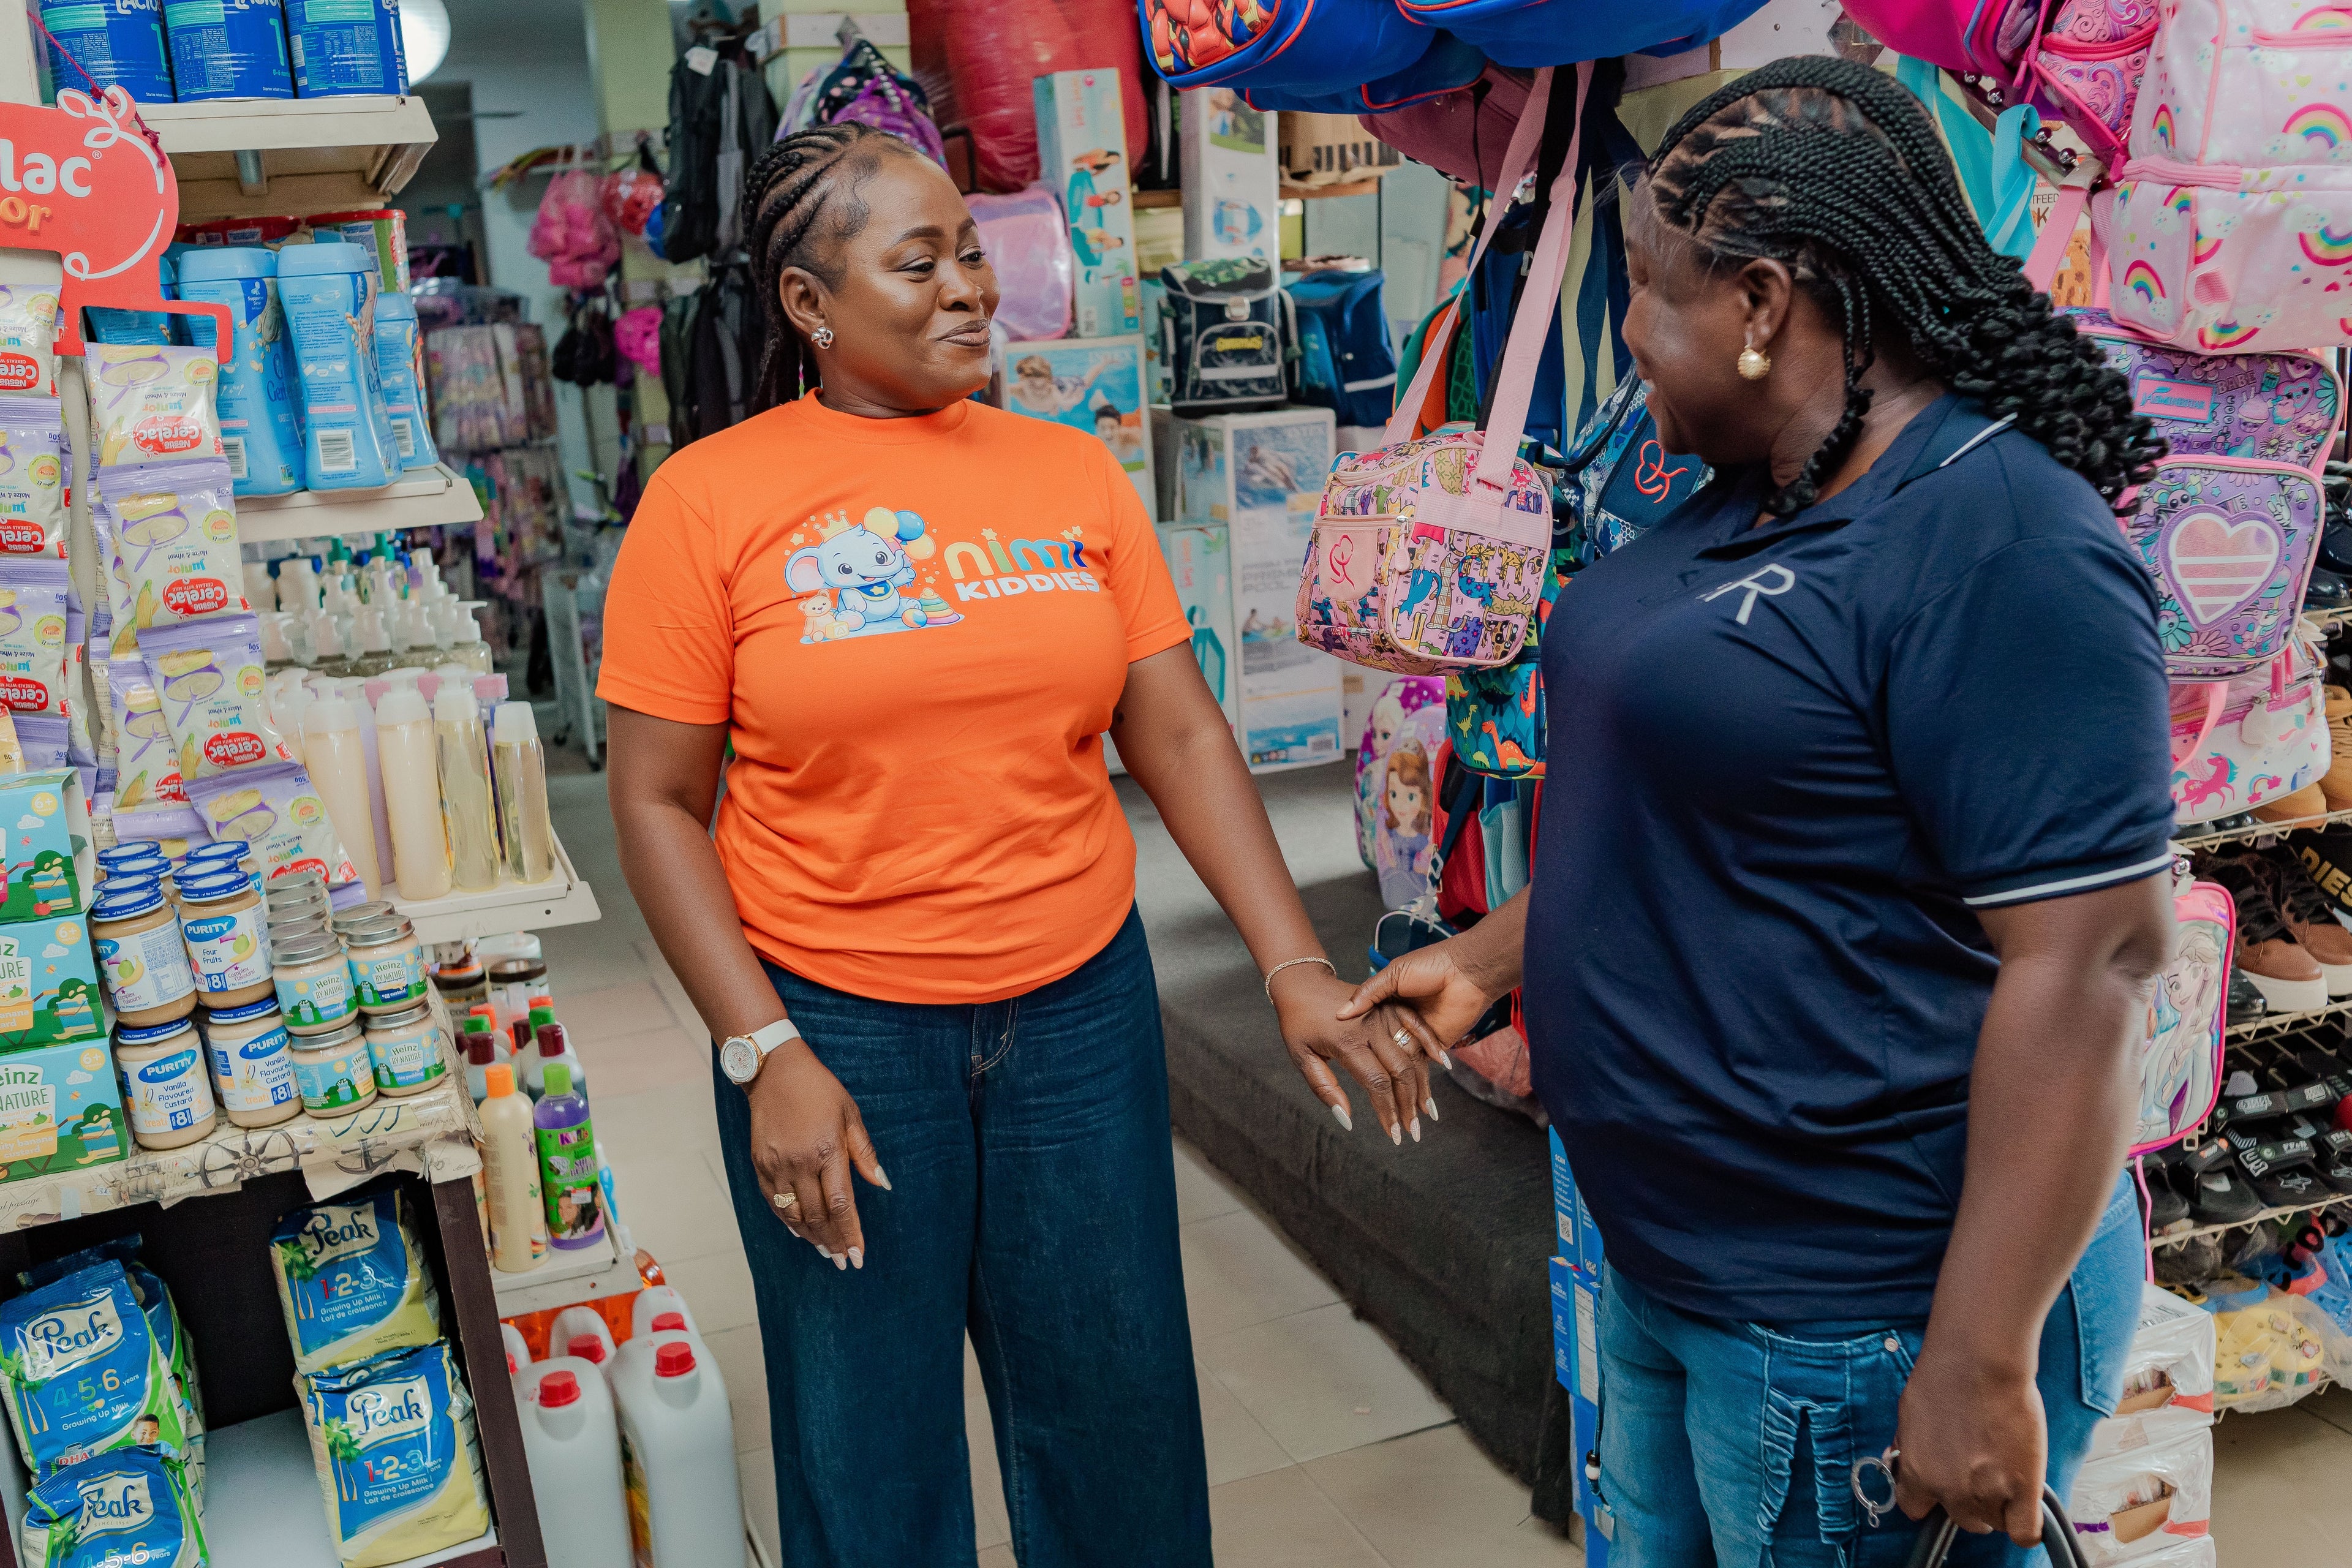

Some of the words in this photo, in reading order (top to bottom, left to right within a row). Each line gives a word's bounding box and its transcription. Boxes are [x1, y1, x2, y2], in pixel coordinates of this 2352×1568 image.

[2217, 371, 2256, 394] BABE
[142, 400, 183, 412] Junior
[138, 426, 199, 441] Cerelac
[944, 527, 1084, 580] nimi
[167, 558, 206, 574] Junior
[954, 571, 1100, 602] KIDDIES
[167, 586, 225, 604] Cerelac
[208, 707, 223, 716] Wheat
[208, 713, 241, 728] Junior
[208, 739, 263, 758] Cerelac
[266, 842, 281, 852] Wheat
[268, 842, 304, 864] Junior
[59, 926, 77, 938] 6+
[187, 921, 229, 935] PURITY
[228, 967, 249, 978] Complex
[375, 962, 401, 973] Heinz
[383, 969, 405, 981] NATURE
[211, 974, 221, 989] 8
[315, 976, 340, 989] Heinz
[118, 992, 135, 1001] Complex
[315, 990, 323, 1000] BY
[324, 984, 344, 997] NATURE
[390, 987, 406, 997] custard
[247, 1030, 288, 1053] PURITY
[392, 1044, 418, 1056] Heinz
[83, 1053, 101, 1065] 6+
[146, 1055, 192, 1076] PURITY
[265, 1056, 285, 1067] Vanilla
[391, 1057, 401, 1065] BY
[400, 1052, 422, 1064] NATURE
[260, 1061, 292, 1078] Flavoured
[353, 1067, 360, 1076] BY
[266, 1071, 291, 1084] Custard
[163, 1080, 187, 1092] Vanilla
[277, 1085, 288, 1101] 8
[157, 1086, 194, 1102] Flavoured
[164, 1095, 192, 1109] Custard
[176, 1110, 187, 1126] 8
[17, 1136, 54, 1147] banana
[4, 1145, 42, 1159] custard
[302, 1210, 375, 1255] Peak
[320, 1265, 376, 1300] 1-2-3
[320, 1301, 352, 1316] Growing
[352, 1298, 363, 1307] Up
[364, 1292, 382, 1303] Milk
[320, 1315, 335, 1324] Lait
[336, 1311, 346, 1319] de
[347, 1300, 388, 1316] croissance
[31, 1311, 115, 1360] Peak
[53, 1368, 120, 1408] 4-5-6
[122, 1373, 140, 1387] years
[62, 1415, 97, 1431] Growing
[97, 1410, 110, 1420] Up
[111, 1401, 130, 1413] Milk
[350, 1388, 424, 1436] Peak
[58, 1451, 89, 1466] DHA
[363, 1449, 424, 1483] 1-2-3
[363, 1486, 397, 1498] Growing
[398, 1482, 409, 1491] Up
[411, 1477, 429, 1487] Milk
[364, 1495, 379, 1505] Lait
[380, 1492, 391, 1501] de
[393, 1482, 434, 1499] croissance
[80, 1485, 145, 1531] Peak
[151, 1550, 172, 1561] years
